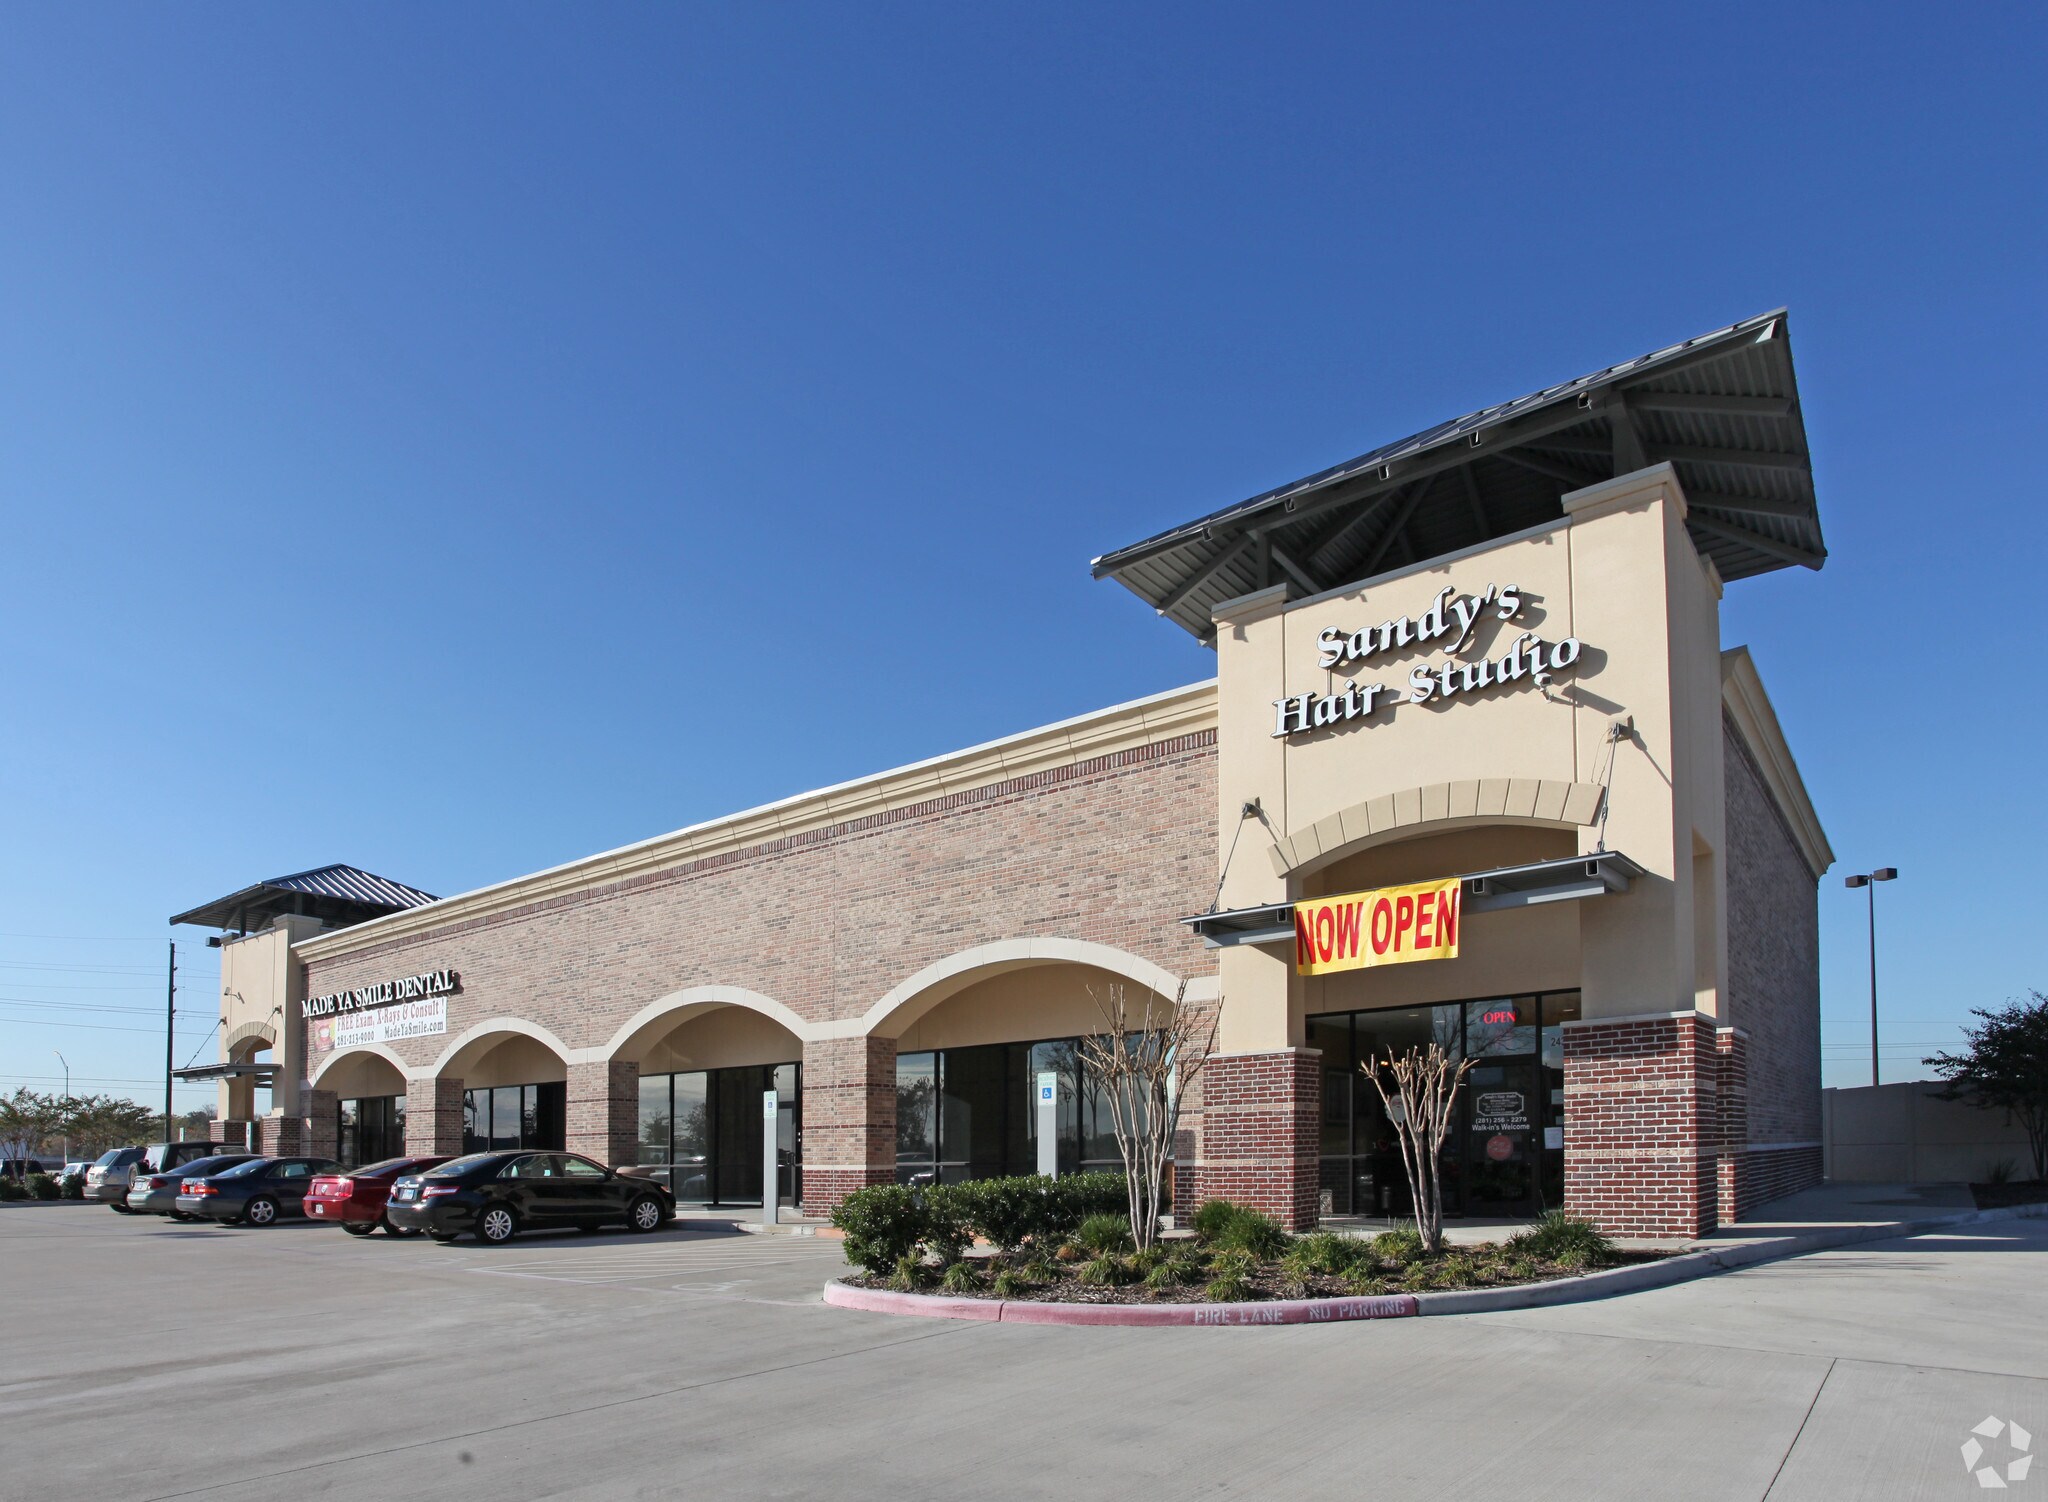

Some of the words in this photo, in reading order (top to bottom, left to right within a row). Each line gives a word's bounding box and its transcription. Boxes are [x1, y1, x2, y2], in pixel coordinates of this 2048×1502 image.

[1317, 583, 1521, 669] Sandy's
[1270, 679, 1385, 738] Hair
[1409, 632, 1583, 704] Studio
[1296, 901, 1364, 966] NOW
[1371, 888, 1459, 955] OPEN
[301, 999, 335, 1018] MADE
[336, 993, 354, 1011] YA
[355, 984, 393, 1008] SMILE
[395, 969, 454, 1000] DENTAL
[337, 1014, 354, 1032] FREE
[355, 1010, 375, 1029] Exam,
[376, 1005, 400, 1025] X-Rays
[410, 1000, 439, 1018] Consult
[384, 1021, 444, 1039] MadeYaSmile.com
[1483, 1010, 1516, 1025] OPEN
[1472, 1123, 1500, 1131] Walk-in's
[1194, 1308, 1230, 1324] FIRE
[1239, 1307, 1283, 1323] LANE
[1309, 1304, 1332, 1320] NO
[1339, 1300, 1406, 1318] PARKING
